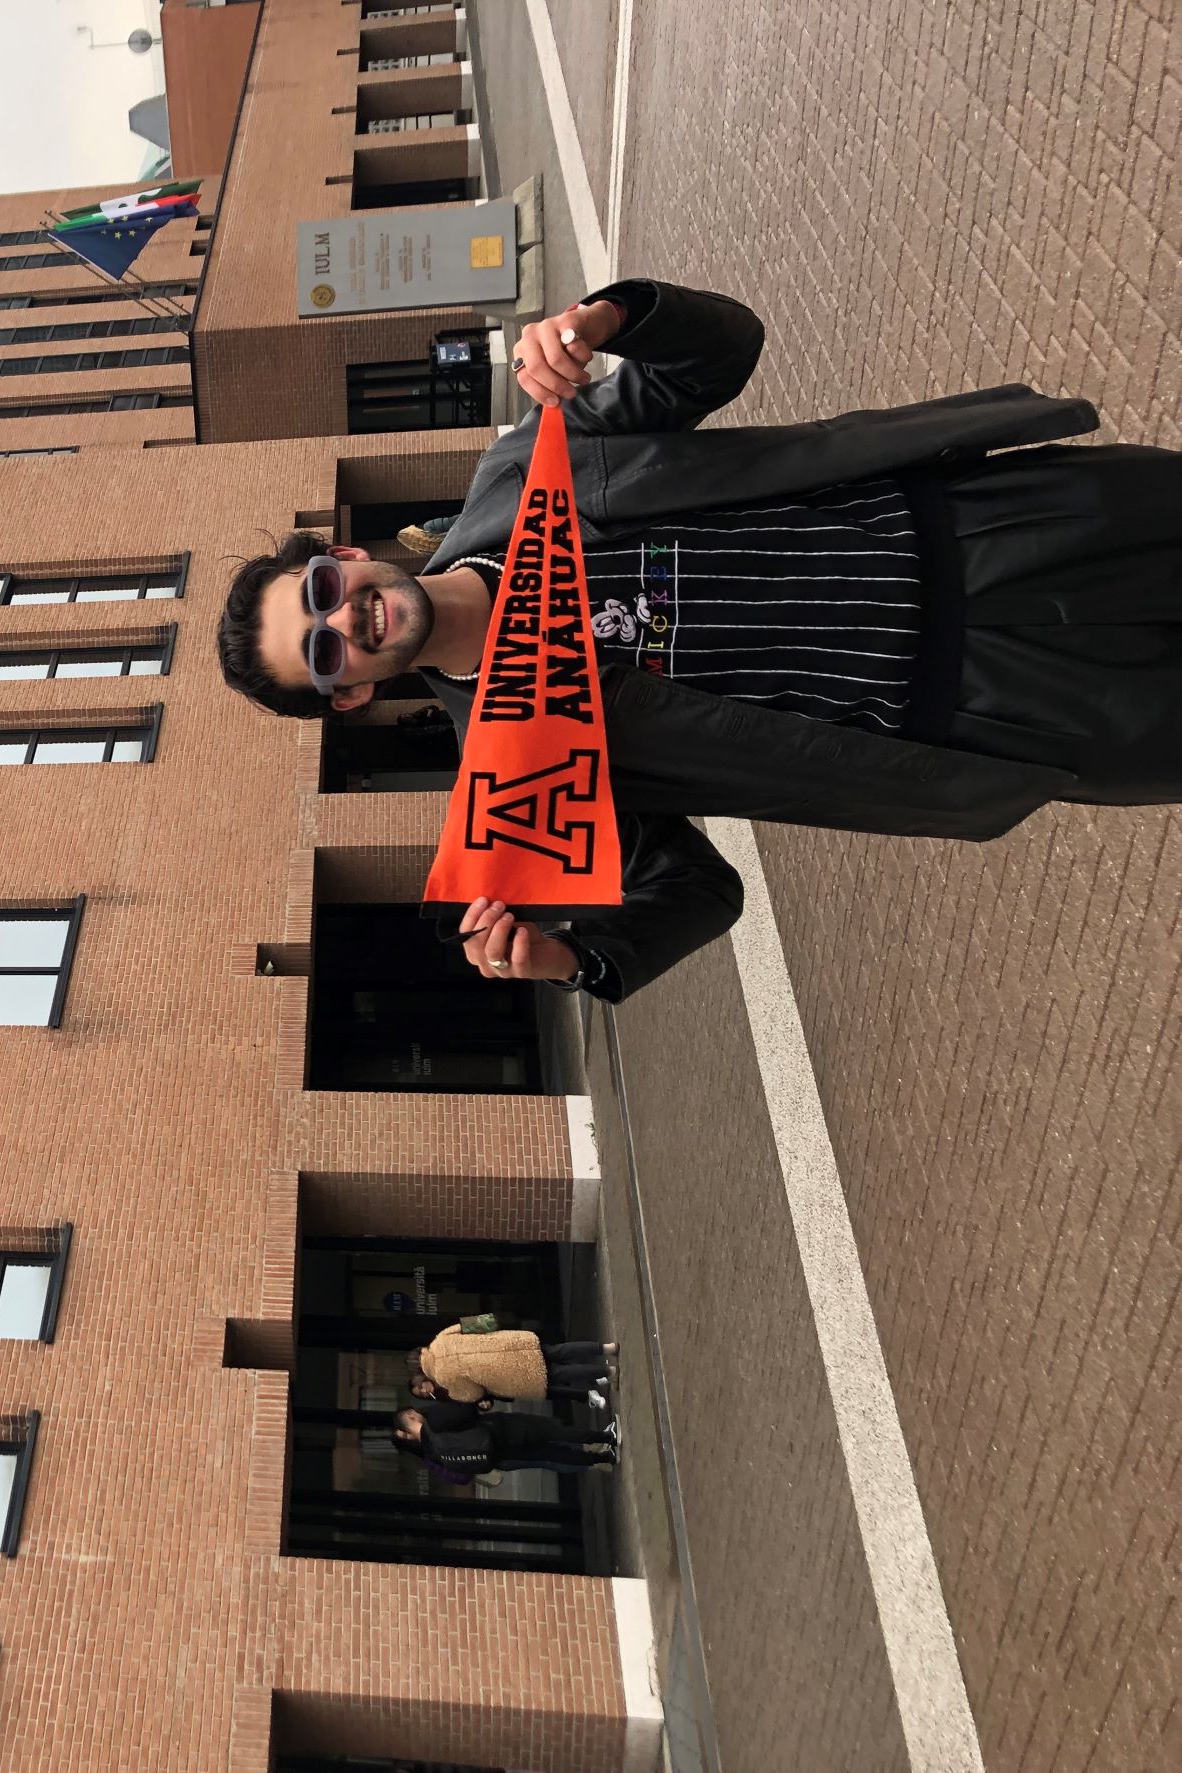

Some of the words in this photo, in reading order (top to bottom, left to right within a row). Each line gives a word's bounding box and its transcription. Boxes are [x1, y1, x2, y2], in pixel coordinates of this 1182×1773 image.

[314, 232, 330, 275] IULM
[479, 488, 549, 723] UNIVERSIDAD
[541, 488, 594, 724] ANÁHUAC
[646, 542, 667, 677] MICKEY
[465, 749, 601, 874] A
[414, 1266, 425, 1314] università
